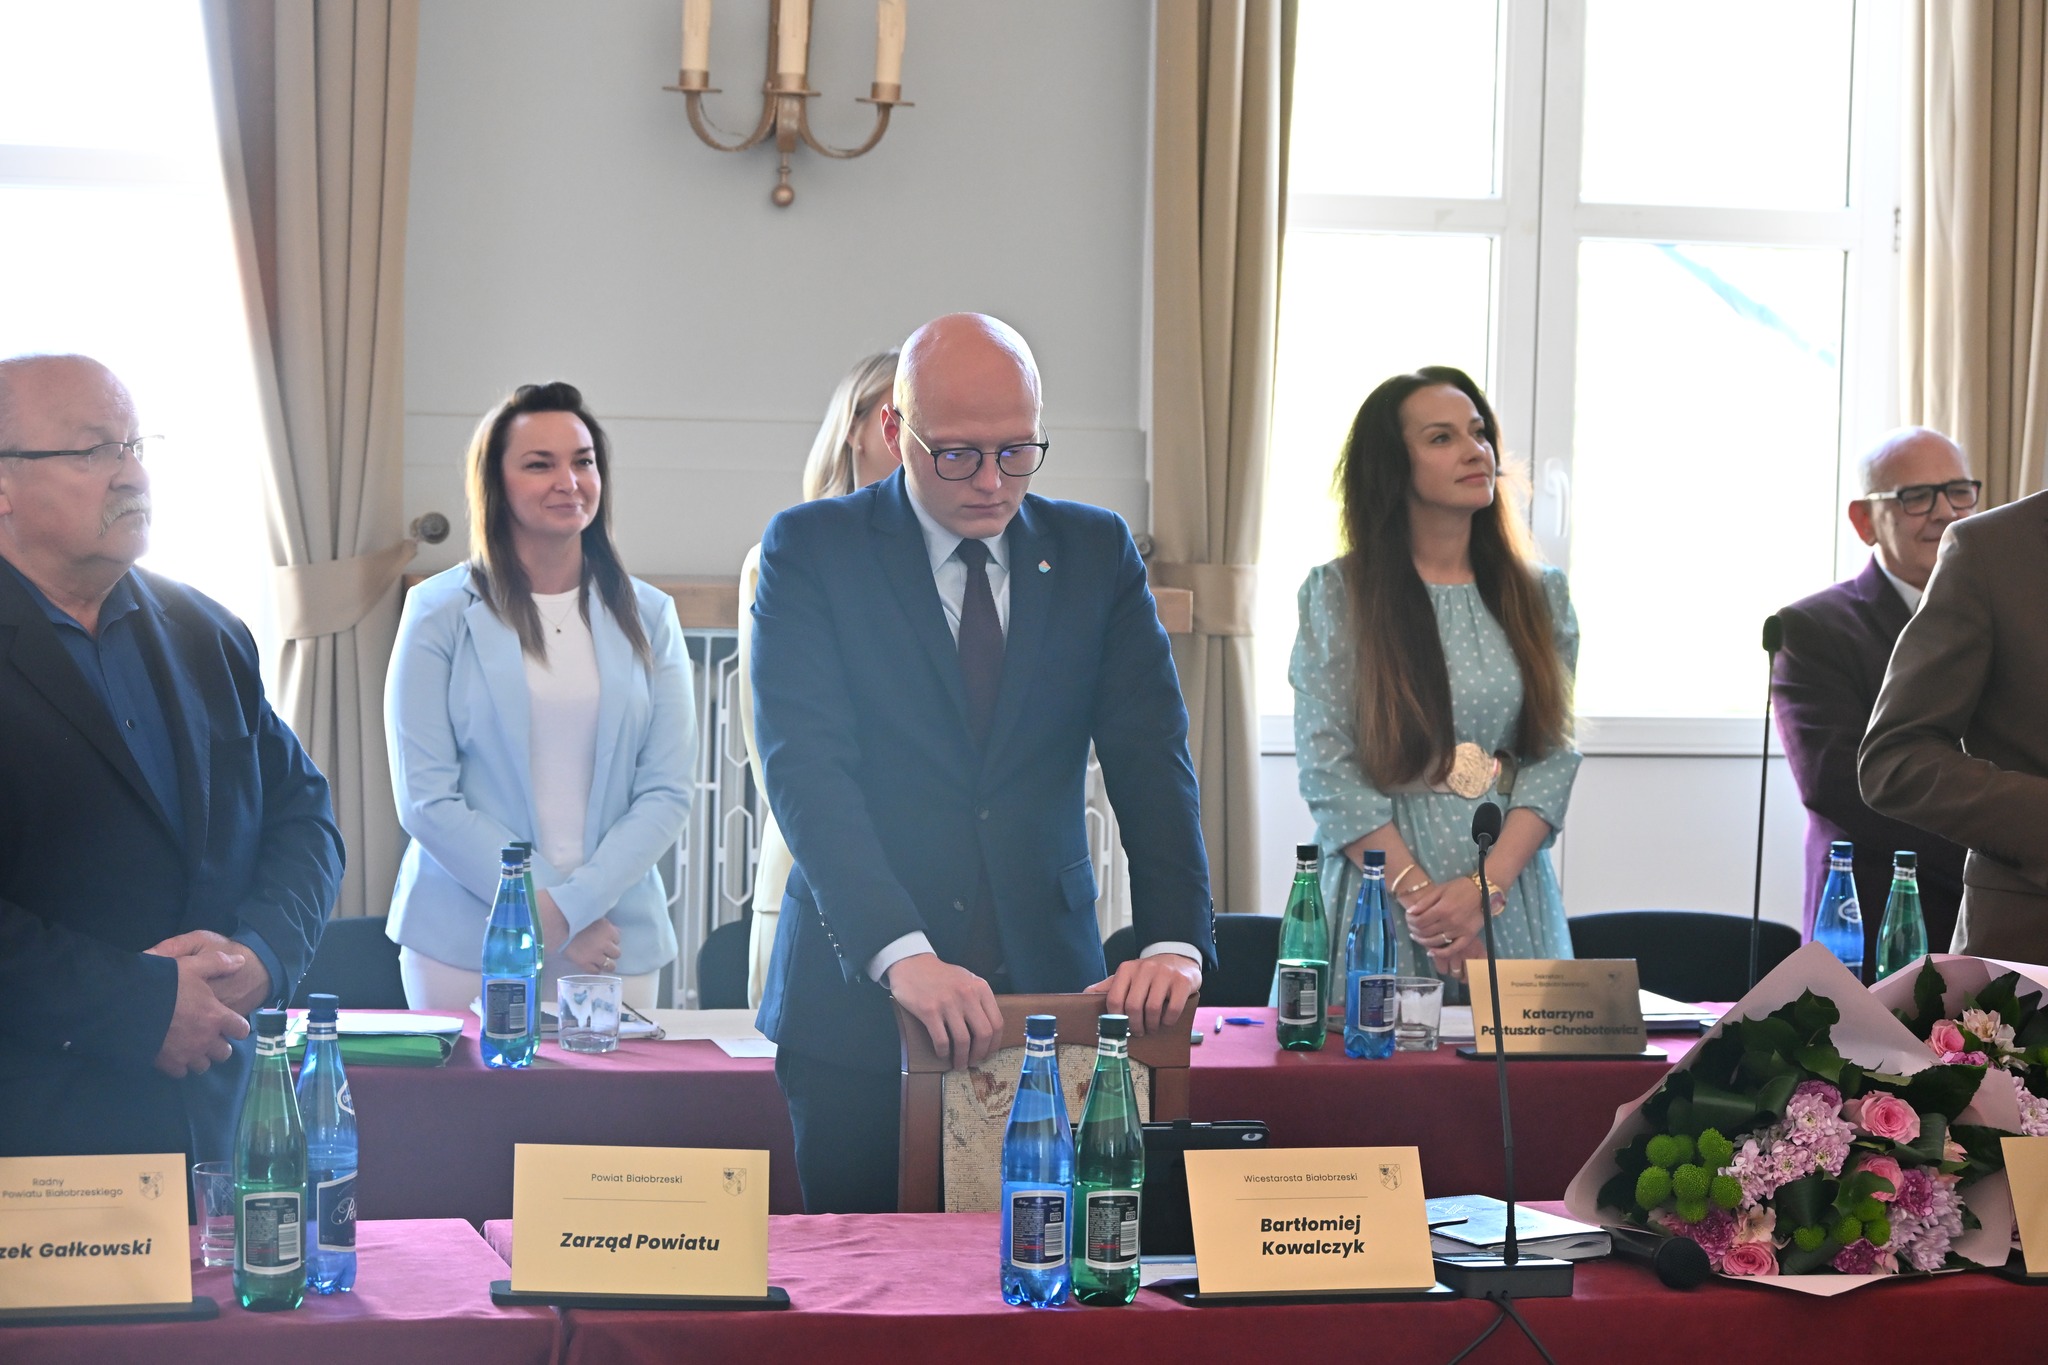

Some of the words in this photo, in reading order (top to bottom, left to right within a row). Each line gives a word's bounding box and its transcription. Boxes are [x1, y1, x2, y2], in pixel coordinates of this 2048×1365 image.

[1522, 1009, 1594, 1023] Katarzyna
[32, 1177, 65, 1188] Radny
[591, 1173, 624, 1183] Powiat
[626, 1174, 683, 1184] Białobrzeski
[1243, 1174, 1303, 1183] Wicestarosta
[1305, 1173, 1358, 1182] Białobrzeski
[2, 1189, 43, 1199] Powiatu
[45, 1187, 124, 1198] Białobrzeskiego
[1260, 1214, 1361, 1236] Bartłomiej
[39, 1238, 152, 1259] Gałkowski
[560, 1232, 633, 1253] Zarząd
[635, 1233, 720, 1251] Powiatu
[1262, 1239, 1366, 1259] Kowalczyk
